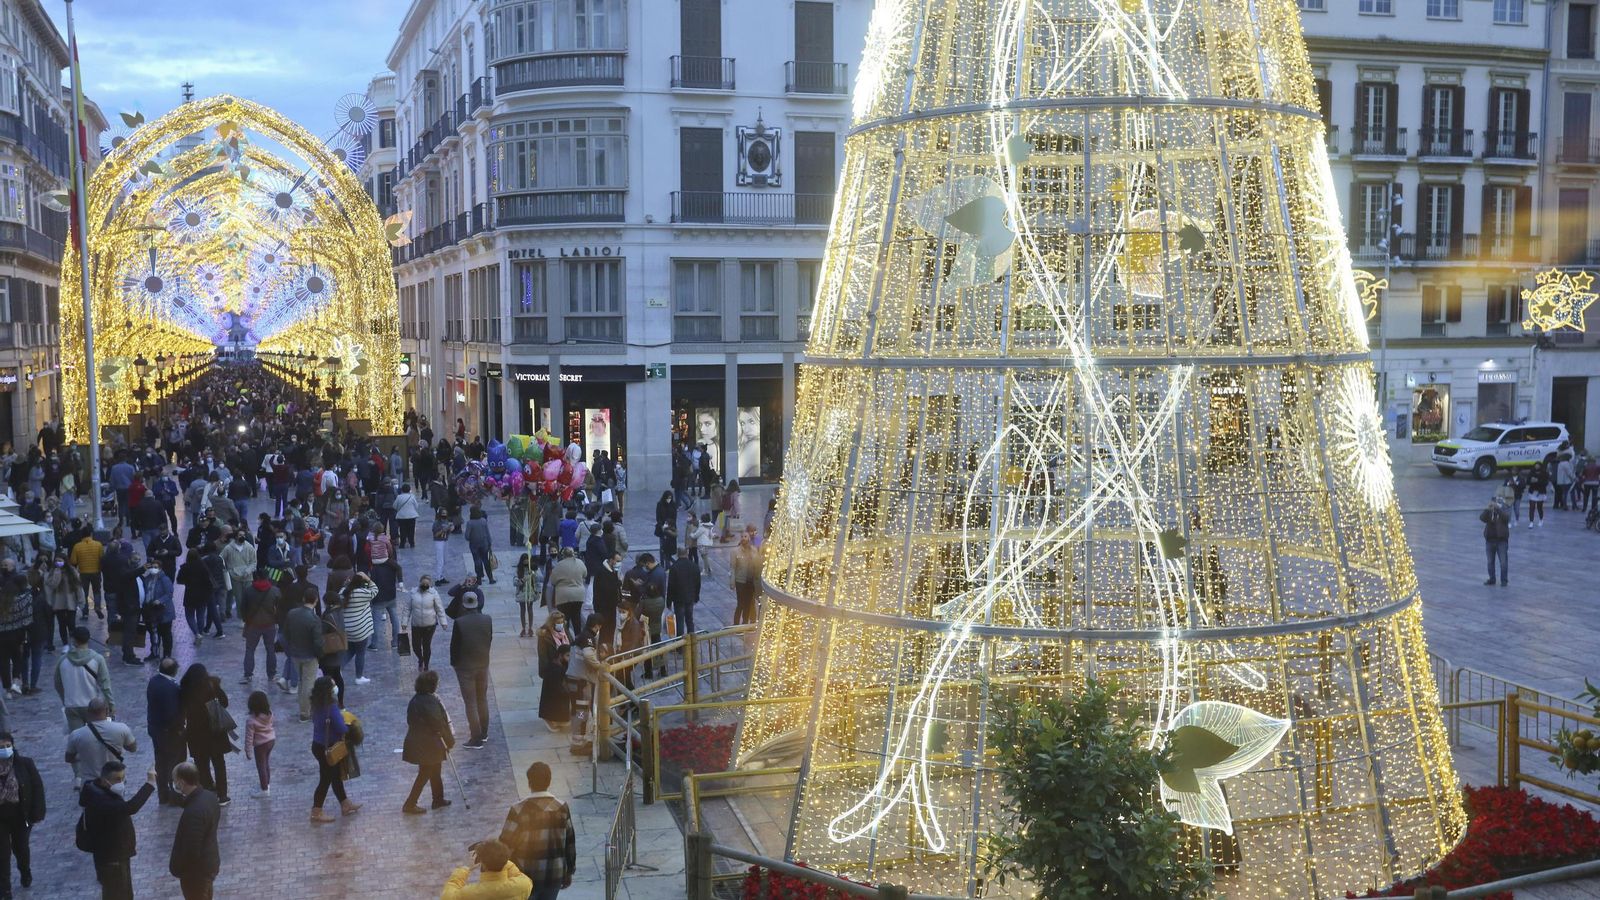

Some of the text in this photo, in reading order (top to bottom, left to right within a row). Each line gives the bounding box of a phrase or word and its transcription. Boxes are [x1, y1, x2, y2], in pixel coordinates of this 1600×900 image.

[508, 248, 545, 259] HOTEL
[515, 373, 583, 382] VICTORIA'S SECRET
